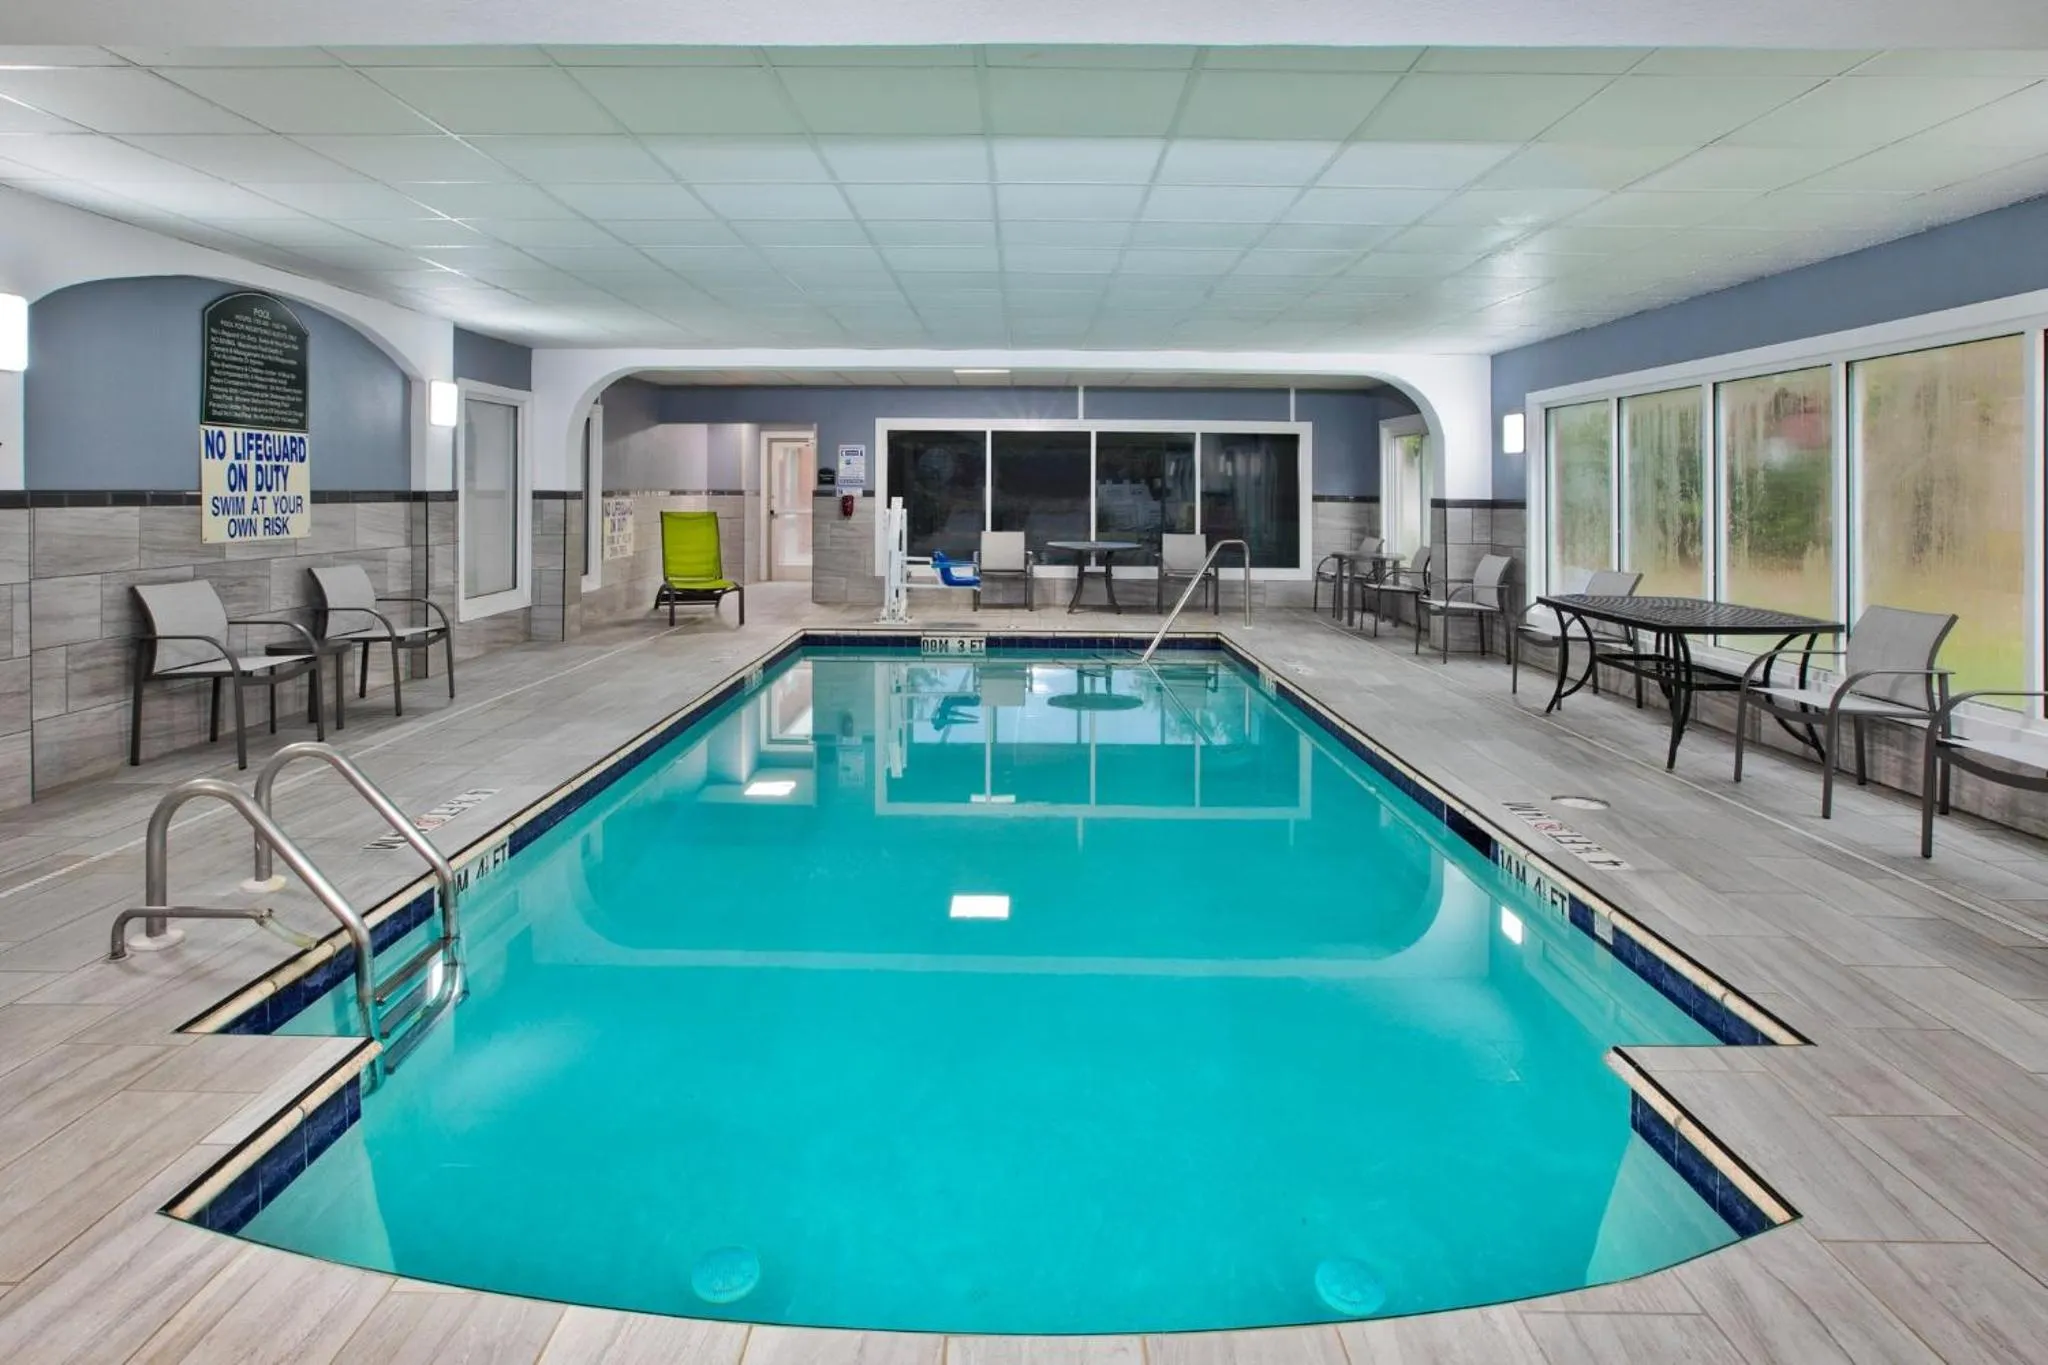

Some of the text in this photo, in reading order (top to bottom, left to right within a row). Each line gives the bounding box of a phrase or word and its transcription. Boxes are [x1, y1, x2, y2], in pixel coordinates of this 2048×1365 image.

[205, 429, 306, 463] NO LIFEGUARD
[227, 462, 289, 492] ON DUTY
[211, 495, 304, 517] SWIM AT YOUR
[227, 516, 290, 538] OWN RISK
[957, 639, 965, 653] 3
[493, 842, 507, 869] FT
[1551, 886, 1566, 917] FT
